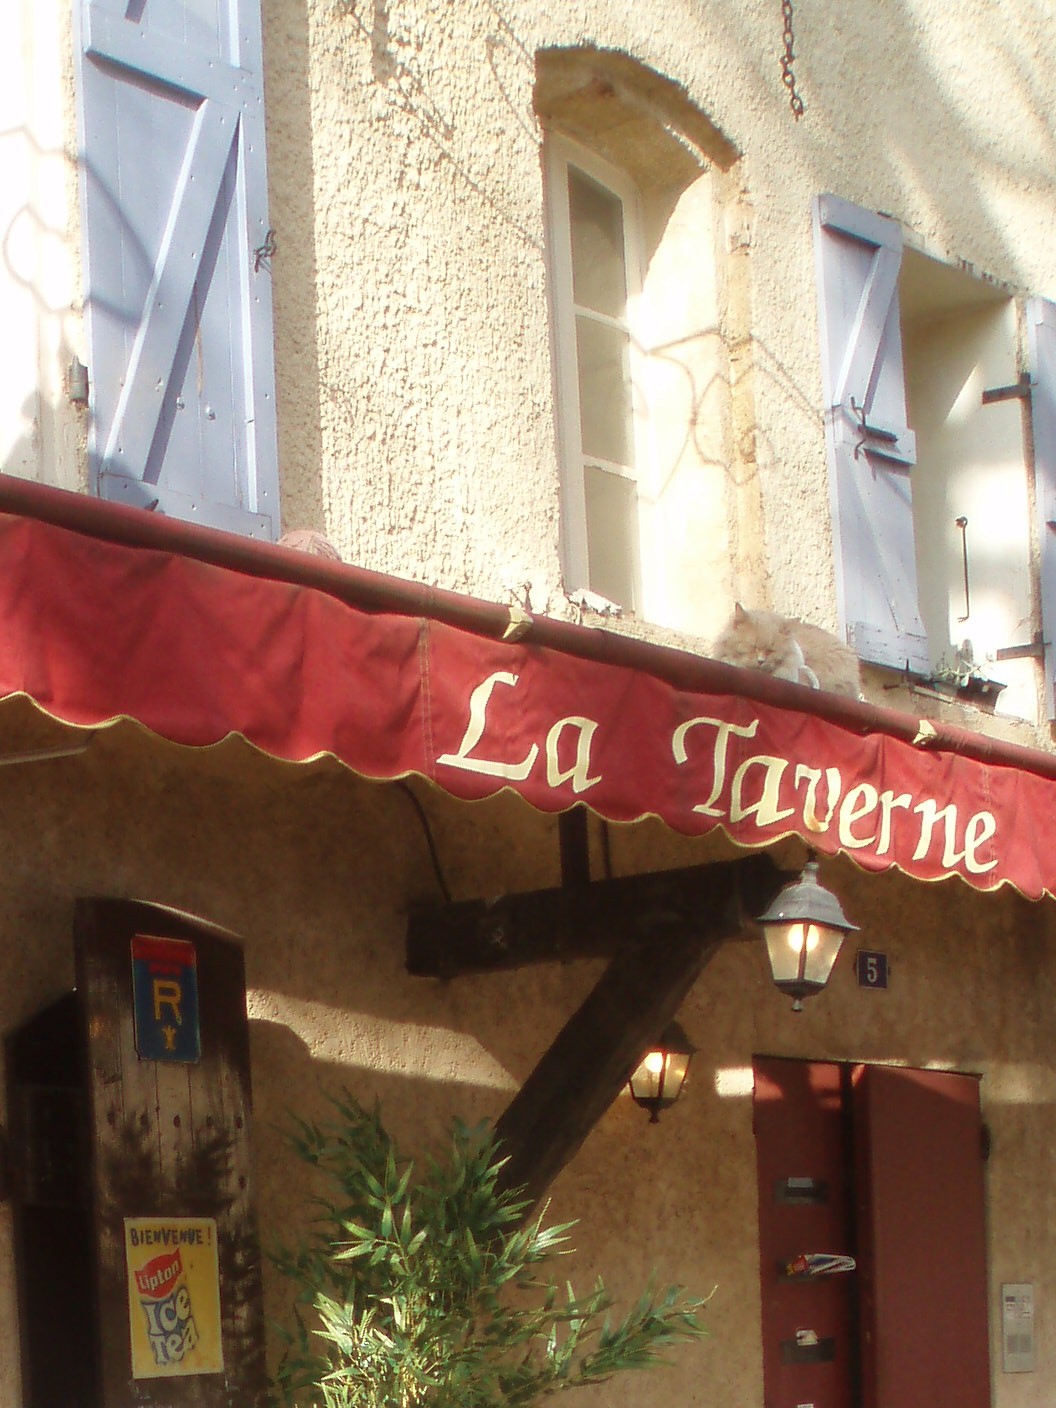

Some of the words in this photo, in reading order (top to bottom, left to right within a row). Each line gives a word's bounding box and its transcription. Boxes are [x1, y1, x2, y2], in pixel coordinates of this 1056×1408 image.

[436, 671, 602, 793] La
[671, 716, 999, 874] Taverne
[866, 956, 879, 984] 5
[152, 978, 183, 1026] R
[130, 1227, 204, 1247] BIENVENUE
[138, 1259, 180, 1291] Lipton
